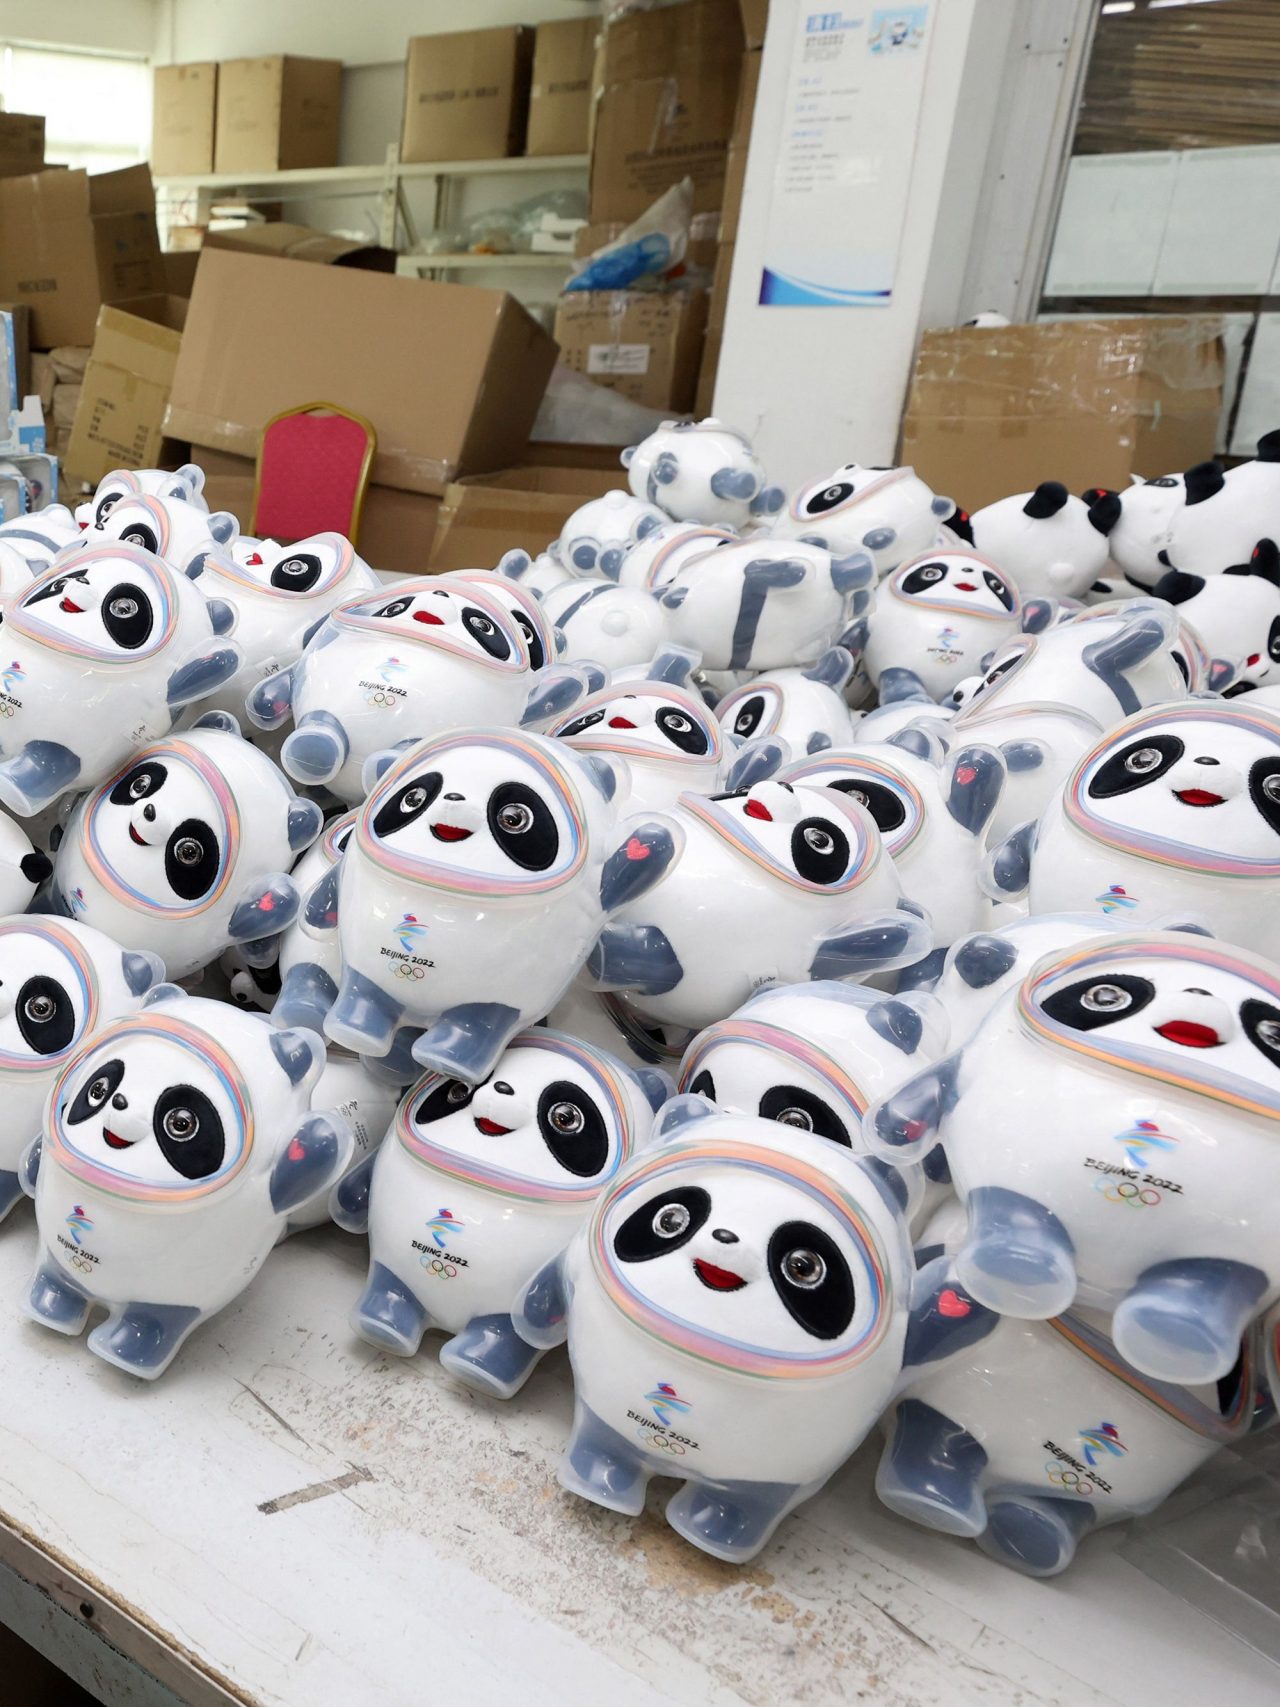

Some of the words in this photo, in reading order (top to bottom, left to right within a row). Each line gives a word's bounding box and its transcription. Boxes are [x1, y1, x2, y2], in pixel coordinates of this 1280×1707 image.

[7, 696, 23, 709] 2022
[358, 680, 387, 690] BEIJING
[387, 685, 408, 697] 2022
[380, 947, 410, 962] BEIJING
[411, 956, 437, 969] 2022
[1083, 1157, 1140, 1180] BEIJING
[1142, 1174, 1184, 1196] 2022
[57, 1234, 79, 1254] BEIJING
[79, 1249, 101, 1265] 2022
[411, 1240, 442, 1258] BEIJING
[443, 1253, 470, 1268] 2022
[626, 1410, 666, 1434] BEIJING
[668, 1431, 702, 1451] 2022
[1042, 1439, 1087, 1473] BEIJING
[1085, 1471, 1113, 1495] 2022
